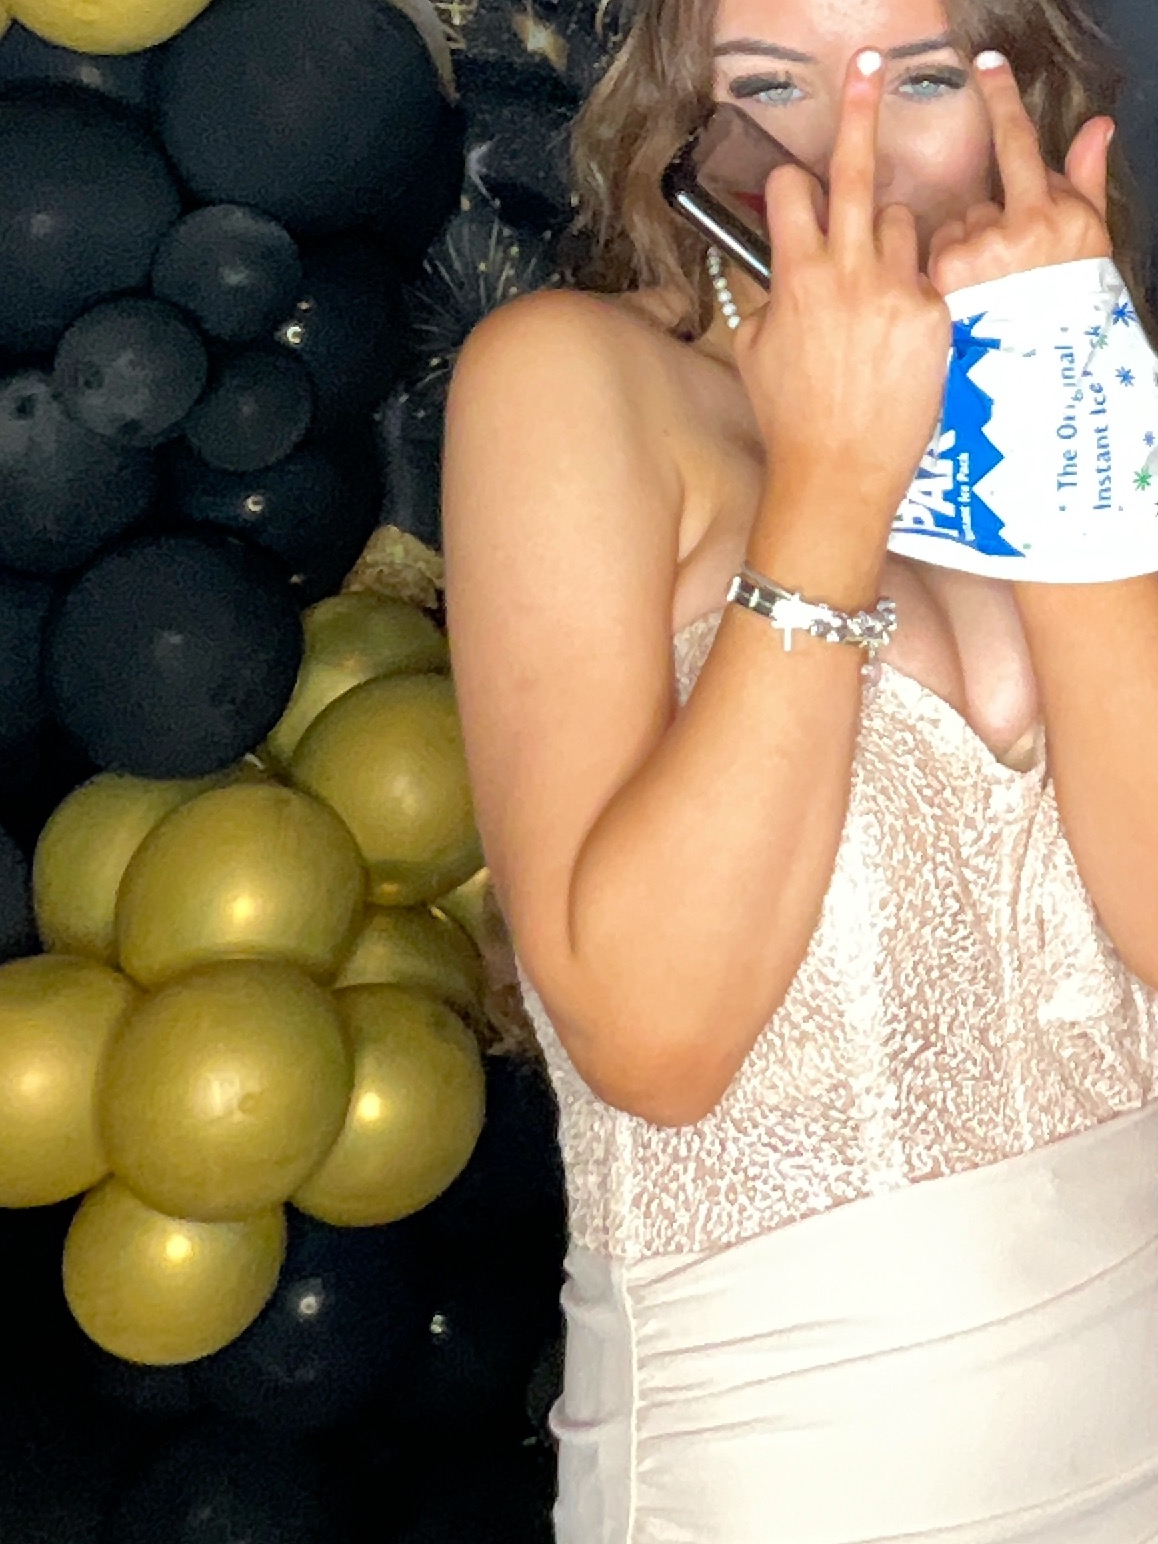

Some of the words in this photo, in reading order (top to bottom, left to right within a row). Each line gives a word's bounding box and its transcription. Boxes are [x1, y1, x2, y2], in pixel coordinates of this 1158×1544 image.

[1088, 382, 1107, 416] Ice
[1056, 449, 1078, 492] The
[1093, 424, 1112, 510] Instant
